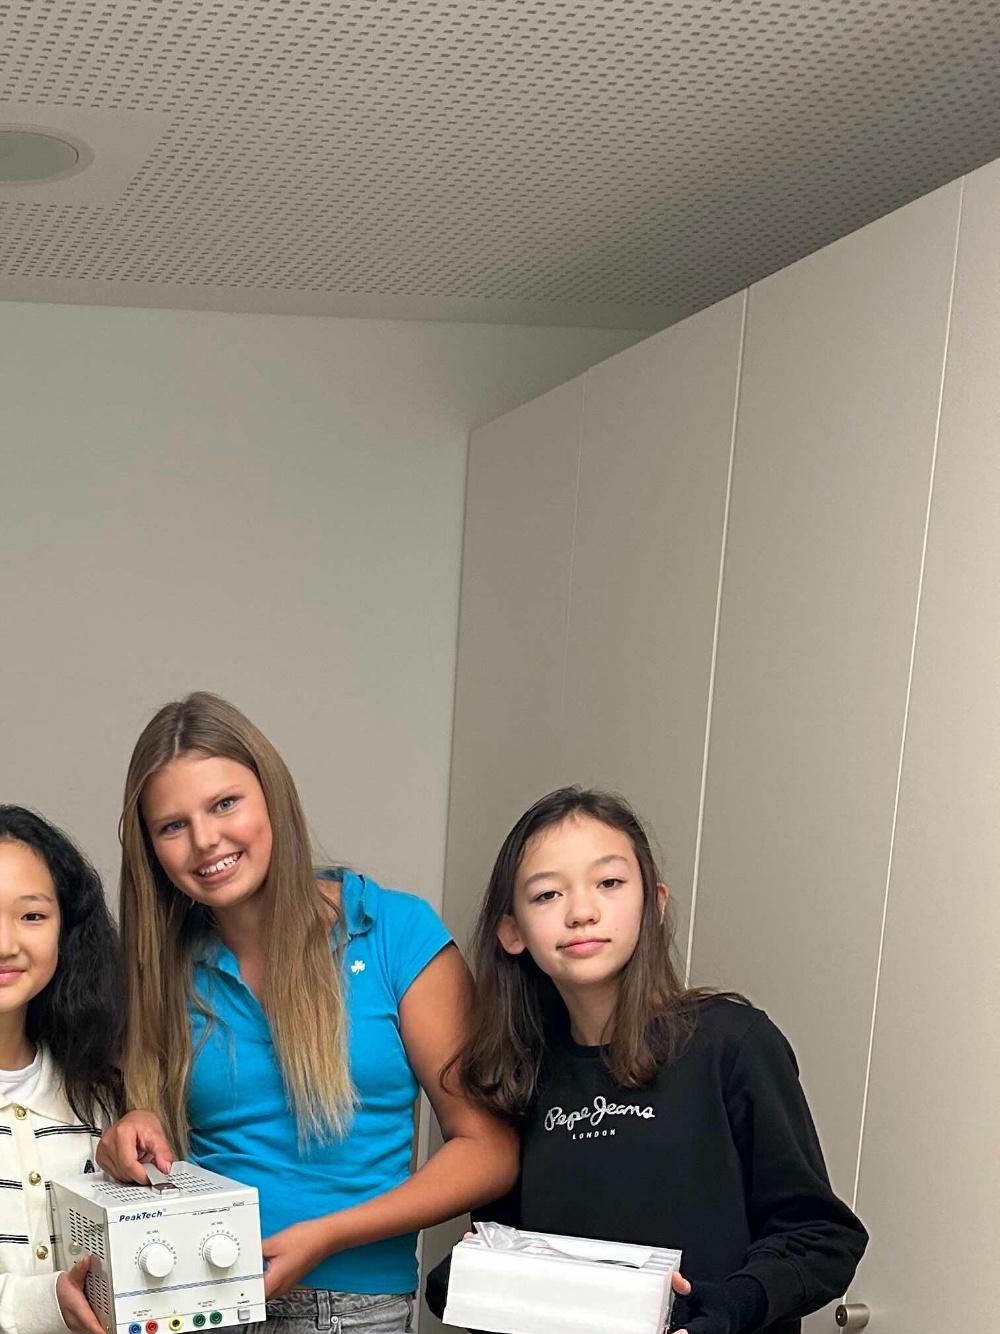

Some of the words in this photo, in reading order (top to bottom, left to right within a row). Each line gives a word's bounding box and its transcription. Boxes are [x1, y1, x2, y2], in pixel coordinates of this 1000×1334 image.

[544, 1107, 591, 1131] Pepe
[590, 1096, 655, 1126] Jeans
[572, 1128, 616, 1140] LONDON
